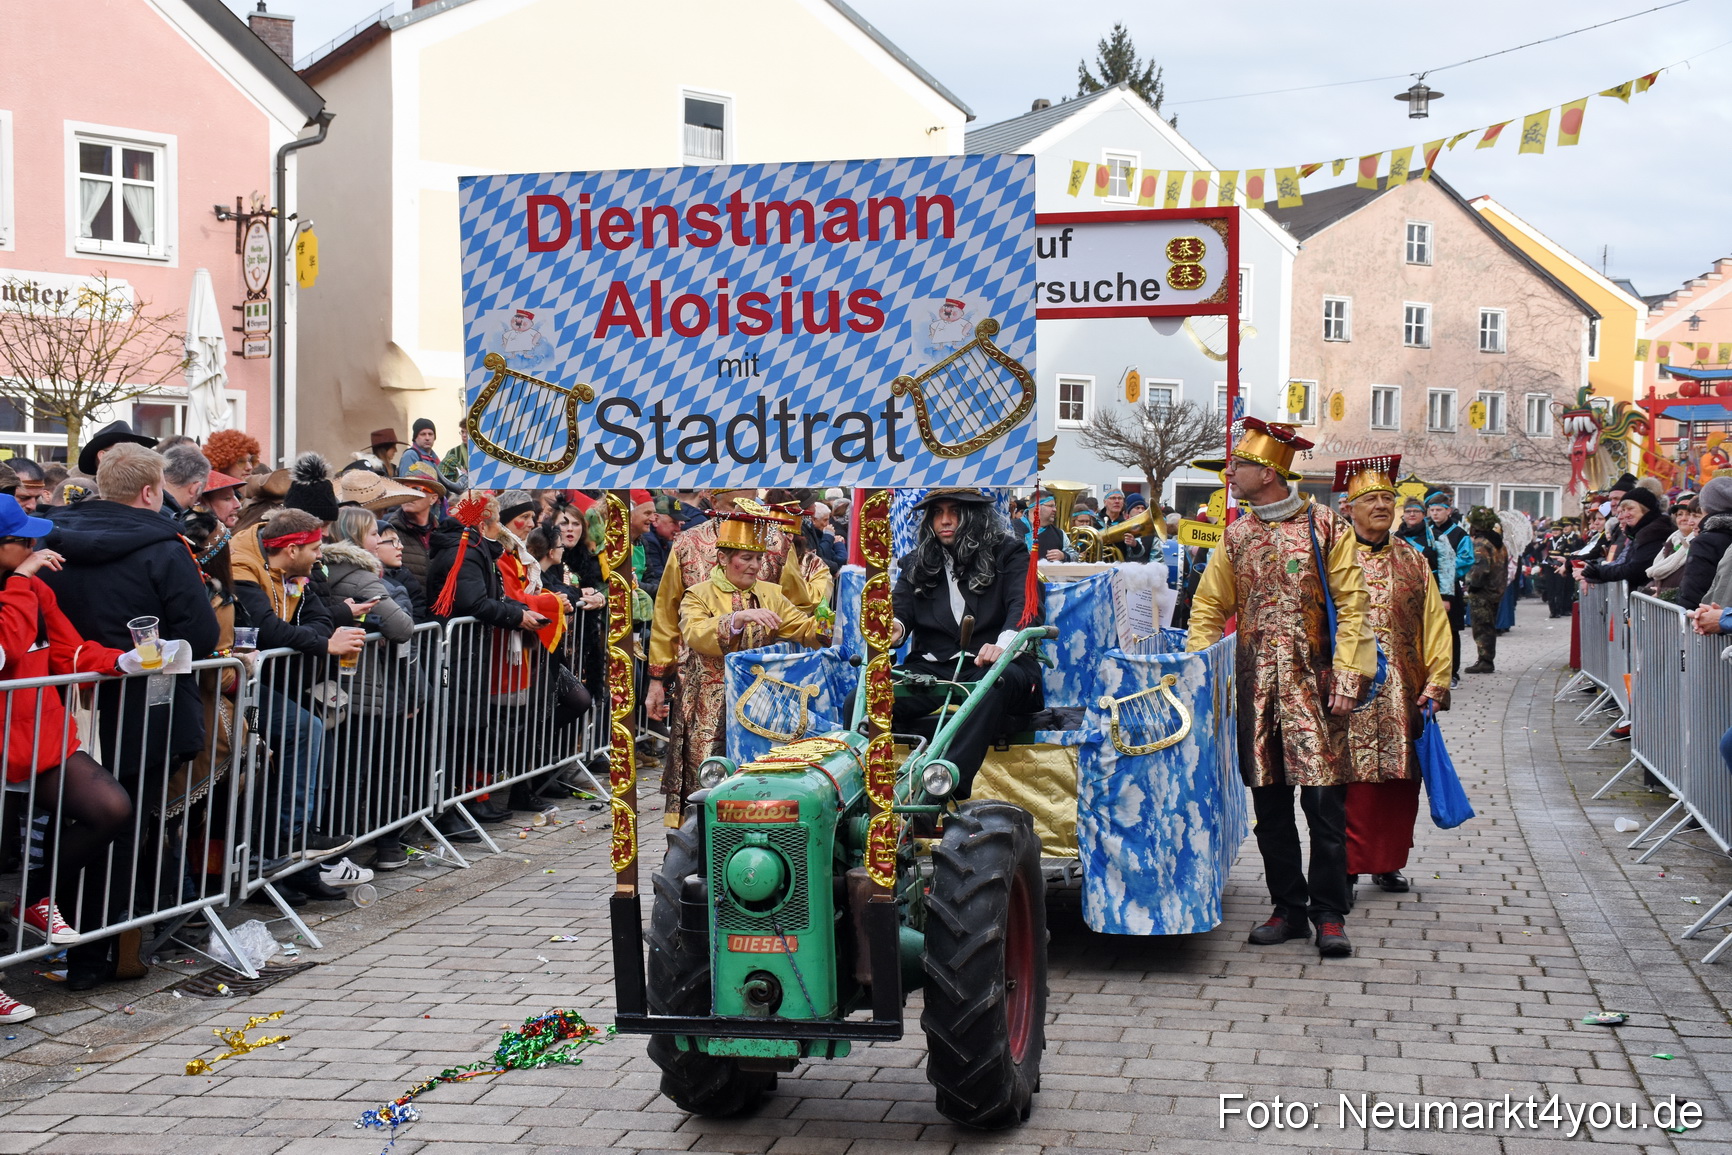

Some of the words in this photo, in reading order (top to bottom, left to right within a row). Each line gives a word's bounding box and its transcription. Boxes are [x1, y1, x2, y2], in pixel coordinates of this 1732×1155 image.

[526, 188, 956, 253] Dienstmann
[1037, 227, 1073, 260] uf
[593, 275, 886, 340] Aloisius
[717, 352, 761, 378] mit
[593, 395, 906, 466] Stadtrat
[719, 803, 799, 821] Holder
[732, 935, 795, 953] DIESEL
